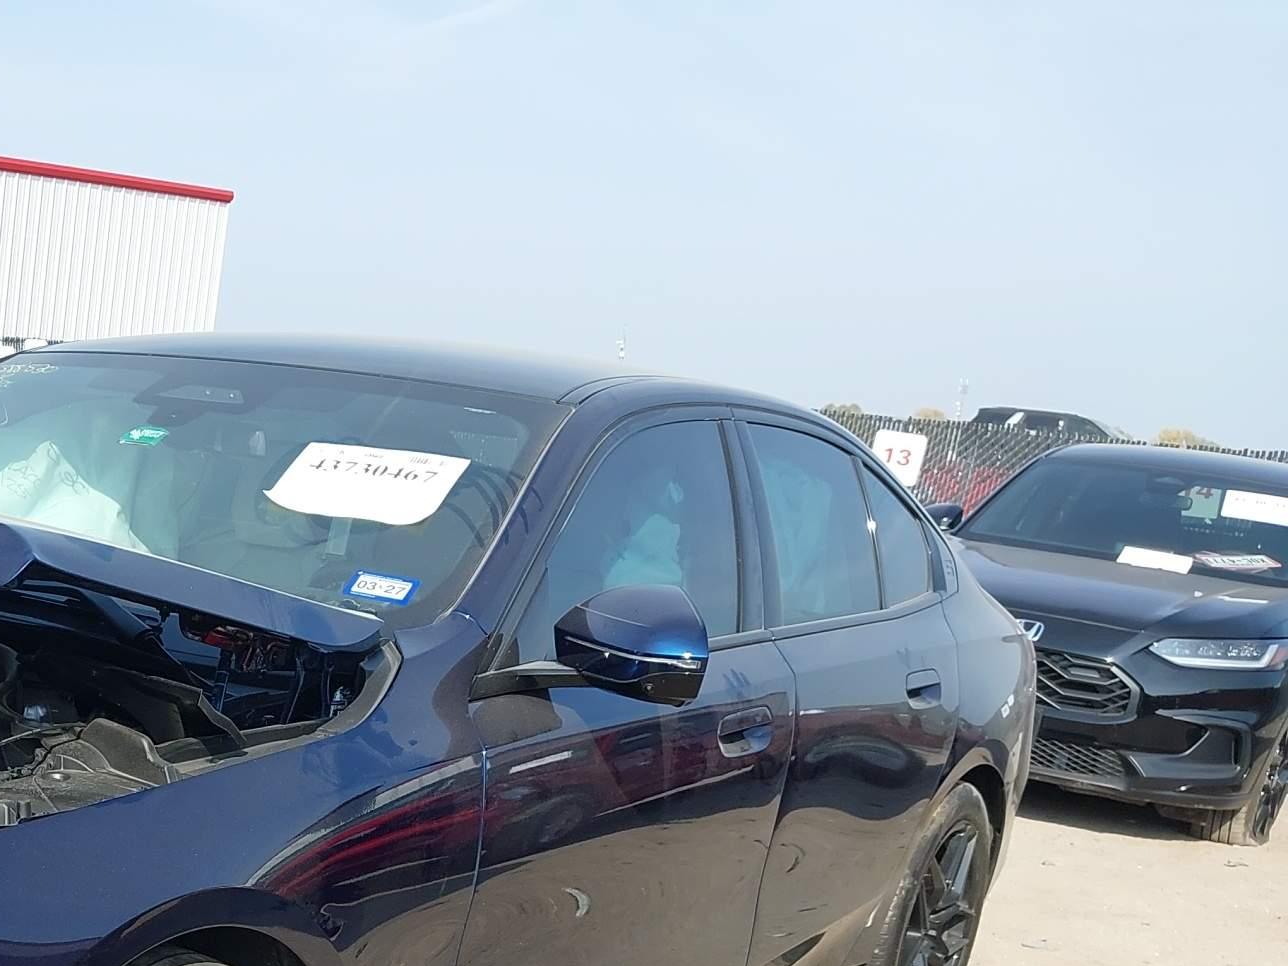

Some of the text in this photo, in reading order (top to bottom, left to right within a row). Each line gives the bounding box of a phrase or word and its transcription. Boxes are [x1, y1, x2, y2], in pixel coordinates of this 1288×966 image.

[884, 447, 912, 466] 13
[309, 458, 439, 483] 43730467
[357, 580, 407, 596] 03 27
